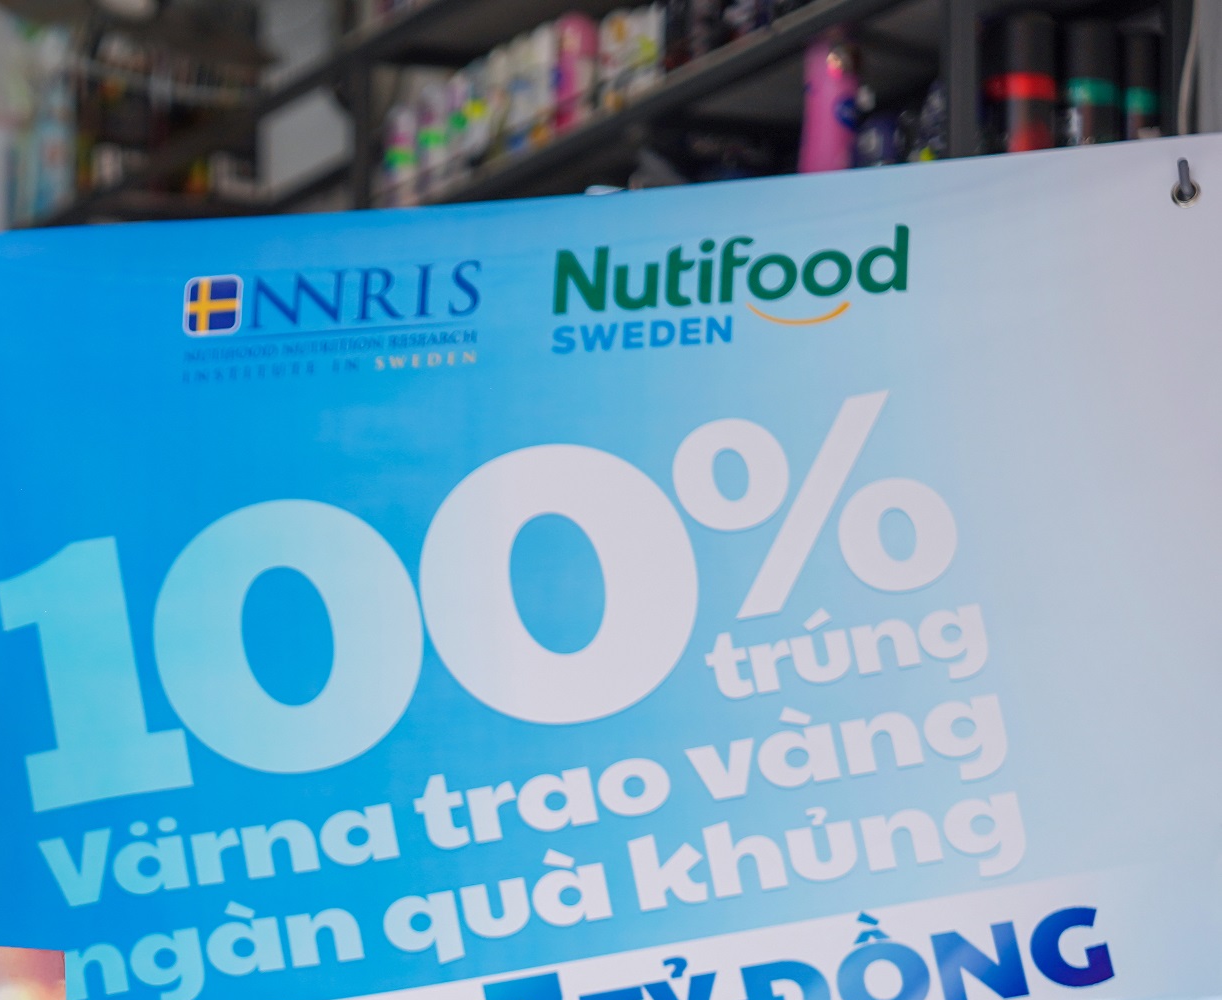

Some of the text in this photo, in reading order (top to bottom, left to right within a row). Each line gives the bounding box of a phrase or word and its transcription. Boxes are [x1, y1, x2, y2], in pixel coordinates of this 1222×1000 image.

[248, 259, 483, 330] NNRIS
[552, 223, 909, 315] Nutifood
[373, 350, 477, 371] SWEDEN
[551, 315, 732, 354] SWEDEN
[705, 605, 989, 700] trúng
[38, 693, 1009, 907] Värna trao vàng
[384, 848, 613, 963] quà
[627, 792, 1027, 912] khủng
